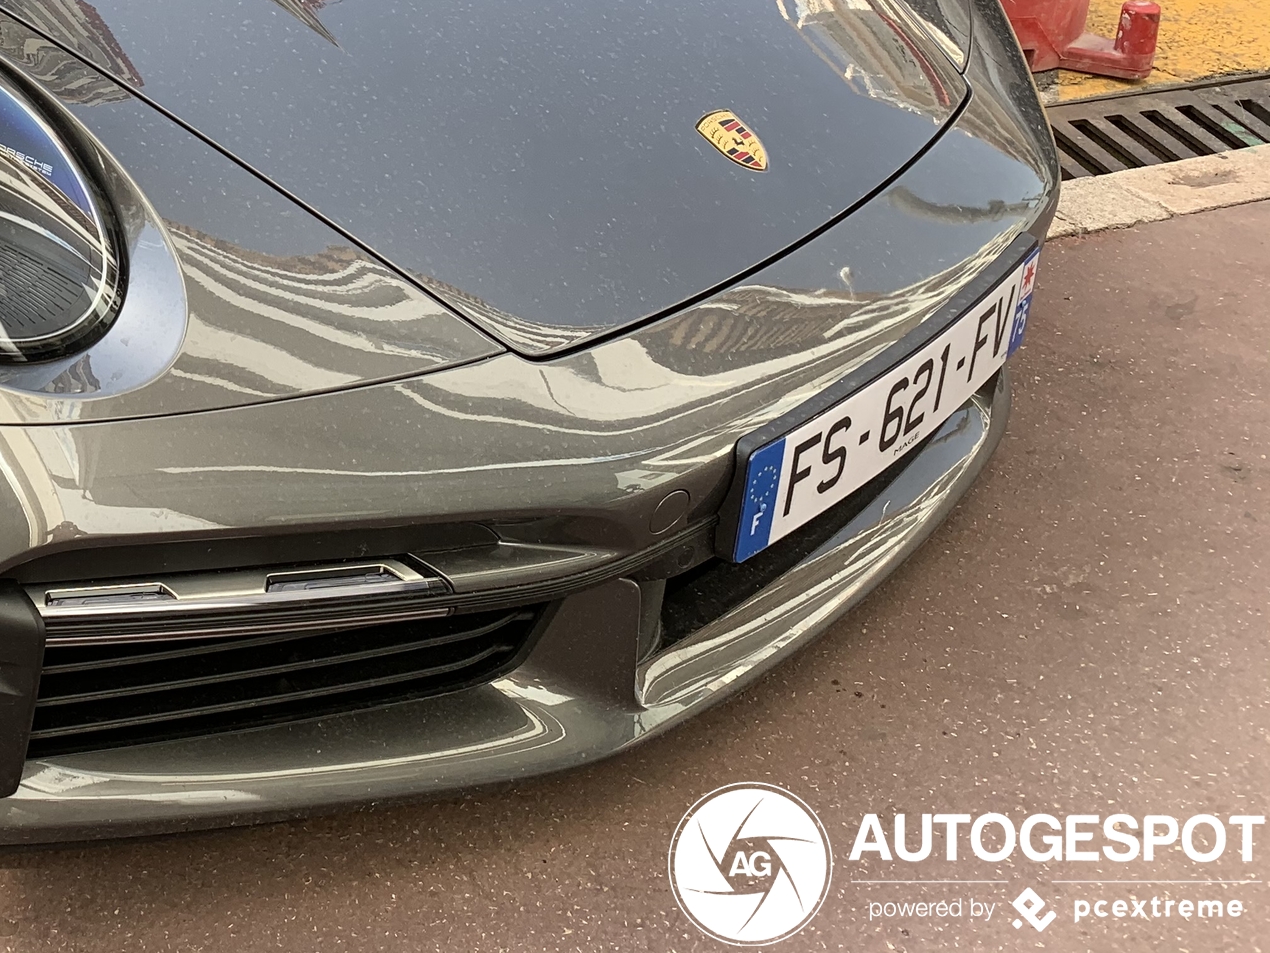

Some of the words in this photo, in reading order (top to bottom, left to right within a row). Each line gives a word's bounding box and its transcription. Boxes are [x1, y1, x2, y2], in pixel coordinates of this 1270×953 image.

[1011, 303, 1029, 343] 75
[782, 284, 1016, 517] FS-621-FV
[750, 513, 763, 537] F
